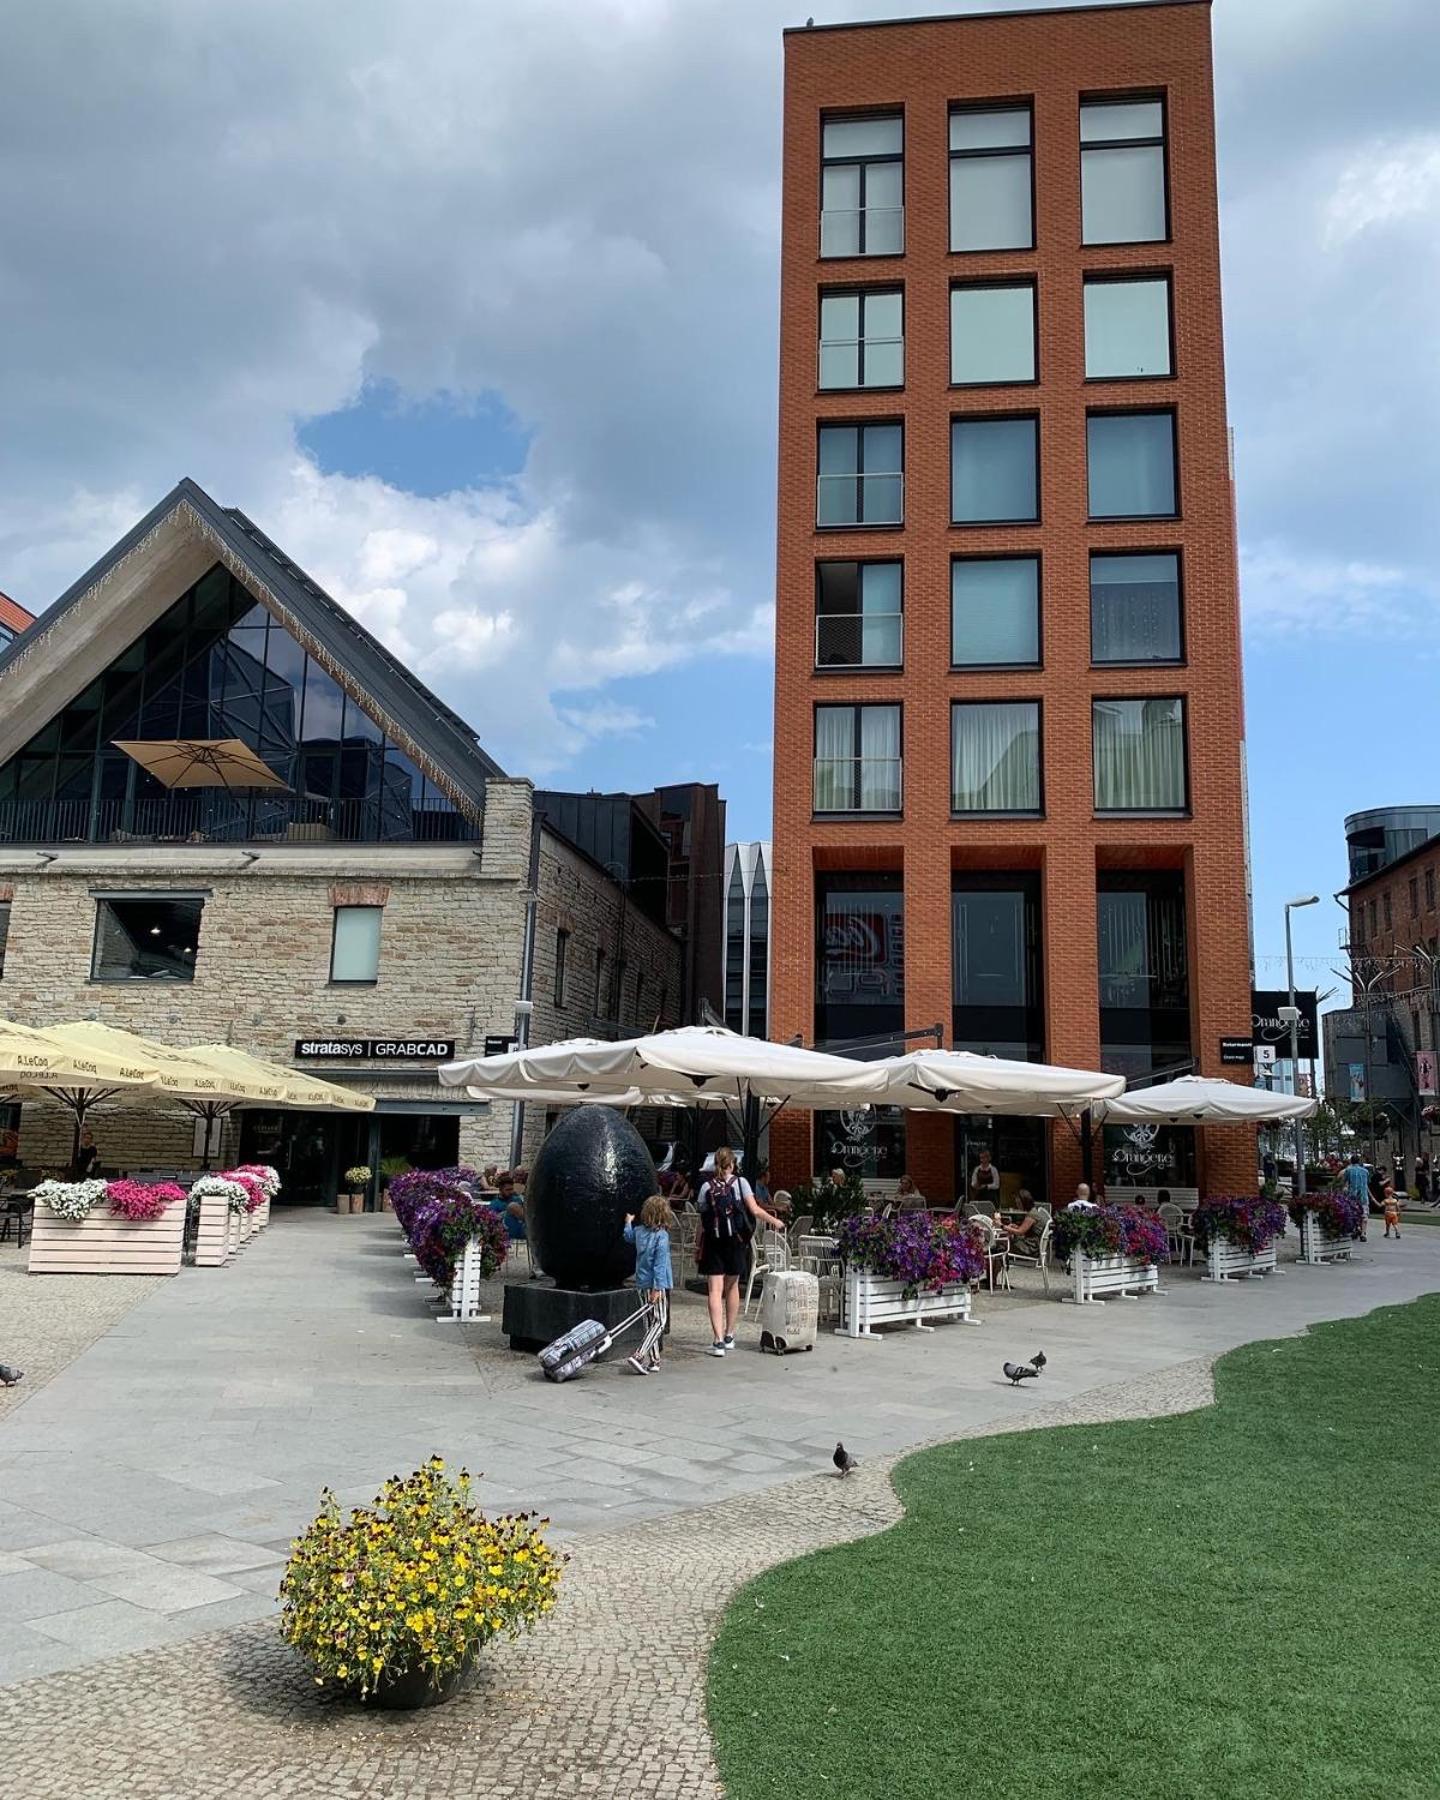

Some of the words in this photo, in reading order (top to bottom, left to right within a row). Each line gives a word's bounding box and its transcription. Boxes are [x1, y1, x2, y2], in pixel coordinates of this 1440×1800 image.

[301, 1041, 363, 1057] stratasys
[375, 1042, 448, 1056] GRABCAD
[1263, 1049, 1270, 1059] 5
